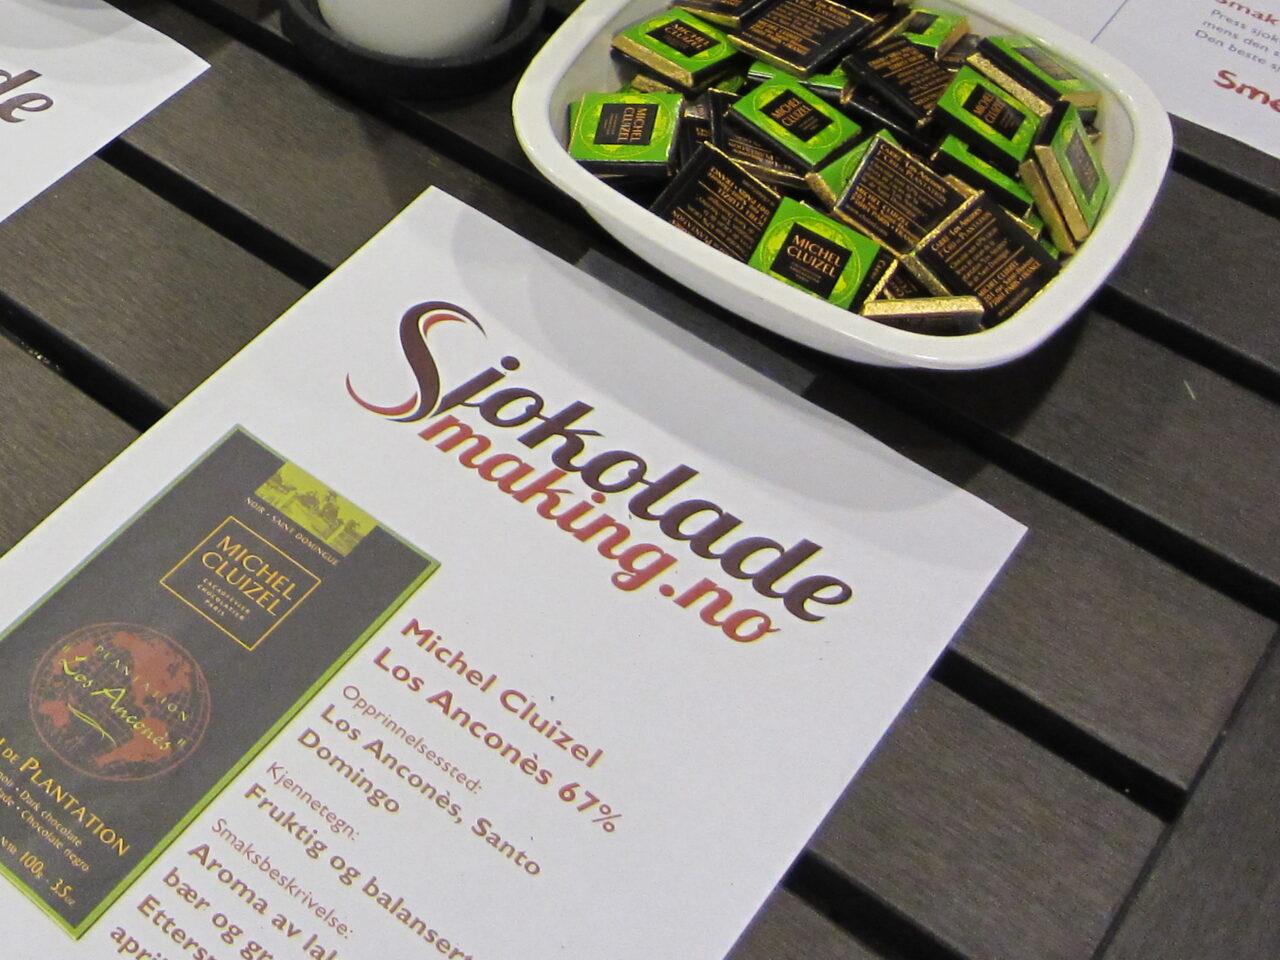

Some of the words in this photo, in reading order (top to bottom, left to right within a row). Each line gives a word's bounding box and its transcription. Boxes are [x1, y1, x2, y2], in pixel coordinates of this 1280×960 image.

[664, 26, 703, 50] CLUIZEL
[672, 23, 711, 47] MICHEL
[1195, 29, 1224, 49] Den
[1228, 43, 1267, 66] beste
[1202, 20, 1239, 39] mens
[1243, 38, 1269, 52] den
[1211, 8, 1246, 30] Press
[617, 106, 633, 142] CLUIZEL
[636, 107, 647, 142] MICHEL
[771, 98, 802, 119] MICHEL
[781, 105, 813, 127] CLUIZEL
[784, 244, 840, 279] CLUIZEL
[791, 233, 846, 268] MICHEL
[345, 300, 854, 622] Sjokolade
[417, 413, 781, 644] making.no
[202, 551, 281, 616] CLUIZEL
[216, 536, 296, 601] MICHEL
[400, 617, 498, 696] Michel
[498, 687, 604, 771] Cluizel
[296, 726, 402, 819] Domingo
[341, 684, 484, 796] Opprinnelsessted:
[372, 646, 426, 696] Los
[426, 678, 553, 789] Anconès
[558, 781, 624, 835] 67%
[1, 746, 21, 766] DE
[19, 756, 131, 857] PLANTATION
[19, 790, 41, 812] Dark
[41, 809, 83, 847] chocolate
[266, 761, 361, 845] Kjennetegn:
[319, 702, 362, 743] Los
[362, 732, 464, 827] Anconès,
[471, 816, 543, 879] Santo
[63, 847, 90, 872] negro
[242, 782, 329, 861] Fruktig
[330, 853, 359, 888] og
[162, 867, 210, 910] bær
[212, 913, 243, 945] og
[188, 843, 269, 917] Aroma
[271, 911, 302, 940] av
[211, 817, 355, 940] Smaksbeskrivelse:
[137, 894, 215, 960] Etters
